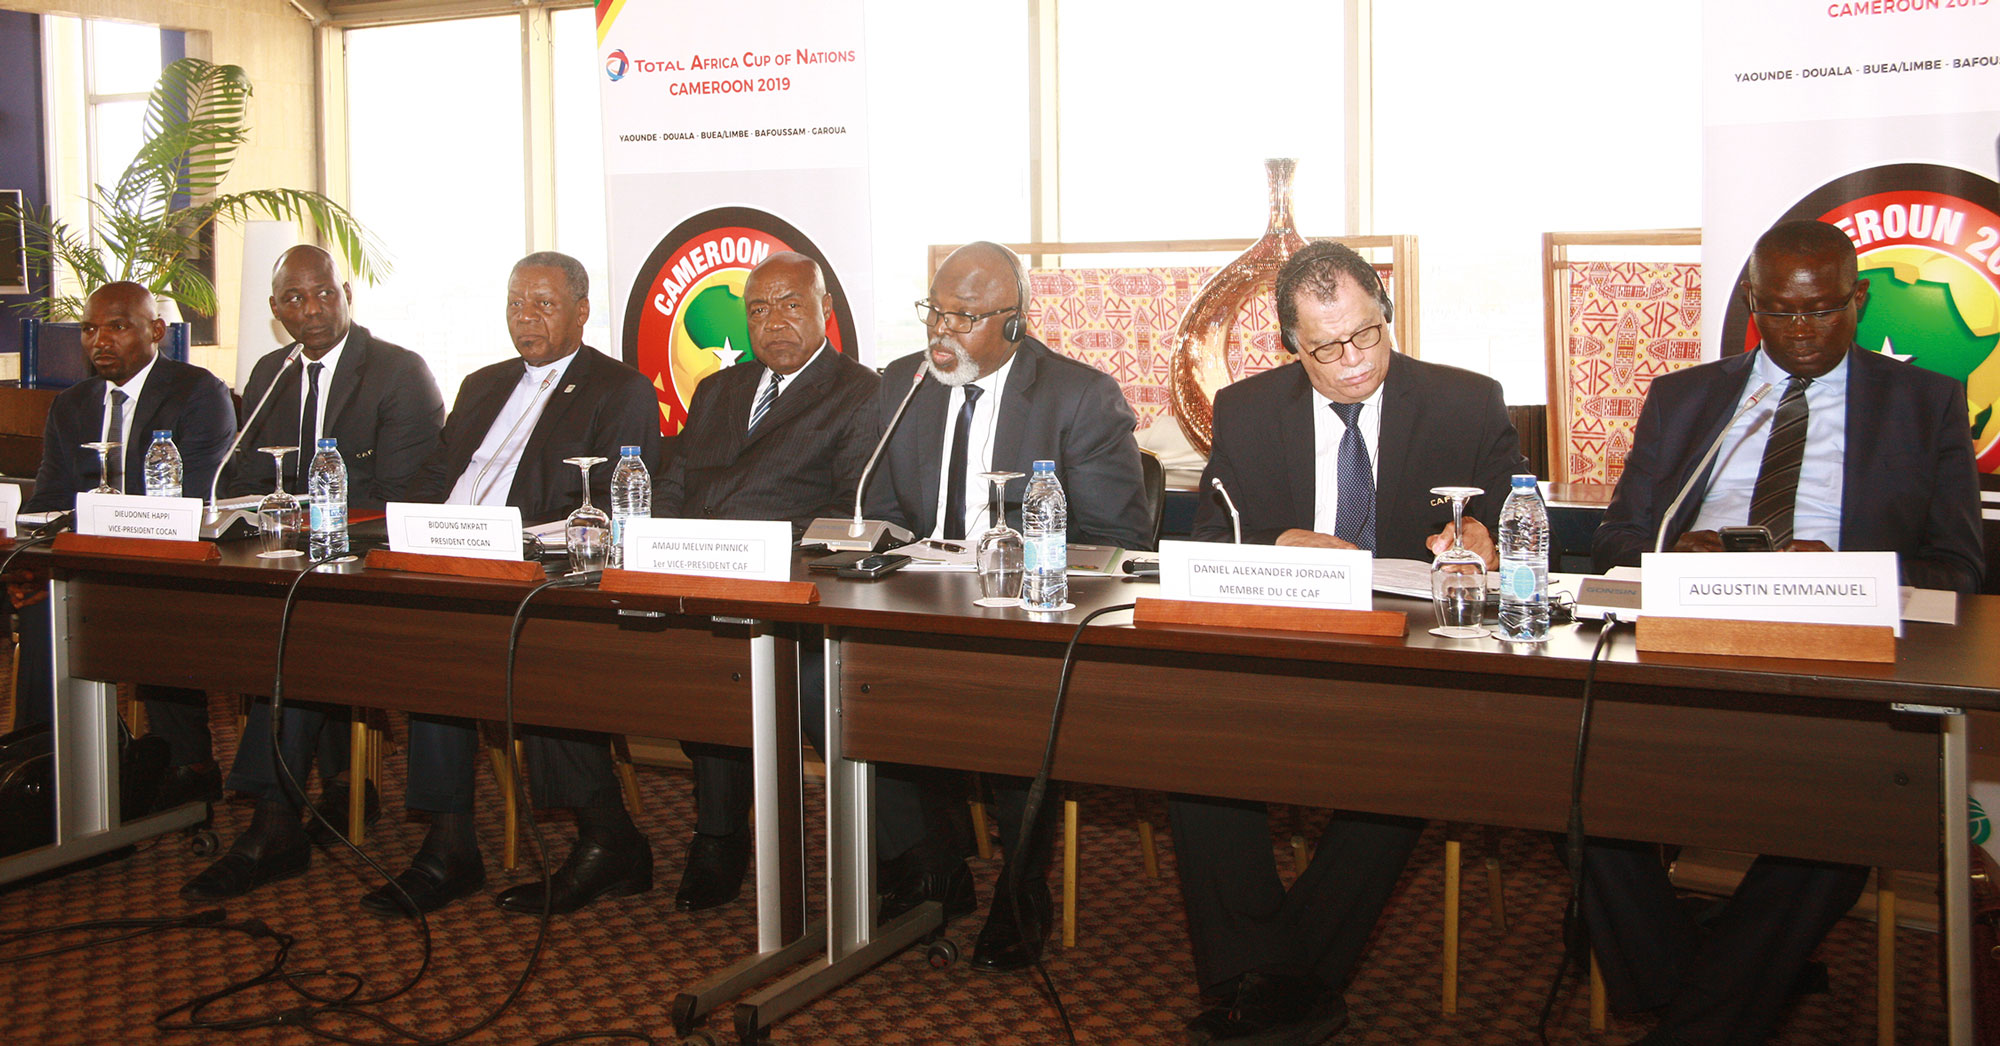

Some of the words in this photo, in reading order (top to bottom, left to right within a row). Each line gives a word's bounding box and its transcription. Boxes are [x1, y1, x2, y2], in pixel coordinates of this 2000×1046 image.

[1827, 0, 1940, 18] CAMEROUN
[633, 60, 686, 73] TOTAL
[690, 55, 740, 71] AFRICA
[742, 52, 771, 68] CUP
[774, 54, 792, 66] OF
[796, 49, 856, 65] NATIONS
[1734, 69, 1793, 83] YAOUNDE
[1802, 65, 1853, 79] DOUALA
[1863, 59, 1942, 75] BUEA/LIMBE
[1952, 55, 2000, 69] BAFOU
[669, 79, 754, 97] CAMEROON
[757, 77, 791, 92] 2019
[619, 134, 658, 143] YAOUNDE
[662, 132, 695, 141] DOUALA
[700, 130, 749, 140] BUEA/LIMBE
[754, 128, 806, 138] BAFOUSSAM
[811, 127, 847, 136] GAROUA
[1833, 203, 1965, 248] EROUN
[654, 236, 770, 316] CAMEROON
[1430, 495, 1451, 507] CAF
[114, 509, 151, 520] DIEUDONNE
[151, 512, 170, 520] HAPPI
[107, 524, 155, 535] VICE-PRESIDENT
[155, 527, 178, 536] COCAN
[427, 520, 460, 530] BIDOUNG
[460, 522, 488, 531] MKPATT
[430, 536, 466, 546] PRESIDENT
[466, 538, 491, 547] COCAN
[651, 541, 681, 551] AMAJU
[682, 542, 714, 552] MELVIN
[715, 543, 749, 553] PINNICK
[653, 559, 666, 569] 1er
[666, 559, 731, 571] VICE-PRESIDENT
[731, 561, 748, 573] CAF
[1193, 564, 1230, 575] DANIEL
[1232, 565, 1293, 577] ALEXANDER
[1295, 568, 1345, 580] JORDAAN
[1218, 584, 1265, 596] MEMBRE
[1267, 587, 1283, 597] DU
[1285, 587, 1298, 598] CE
[1300, 588, 1321, 598] CAF
[1689, 583, 1768, 596] AUGUSTIN
[1773, 583, 1868, 597] EMMANUEL
